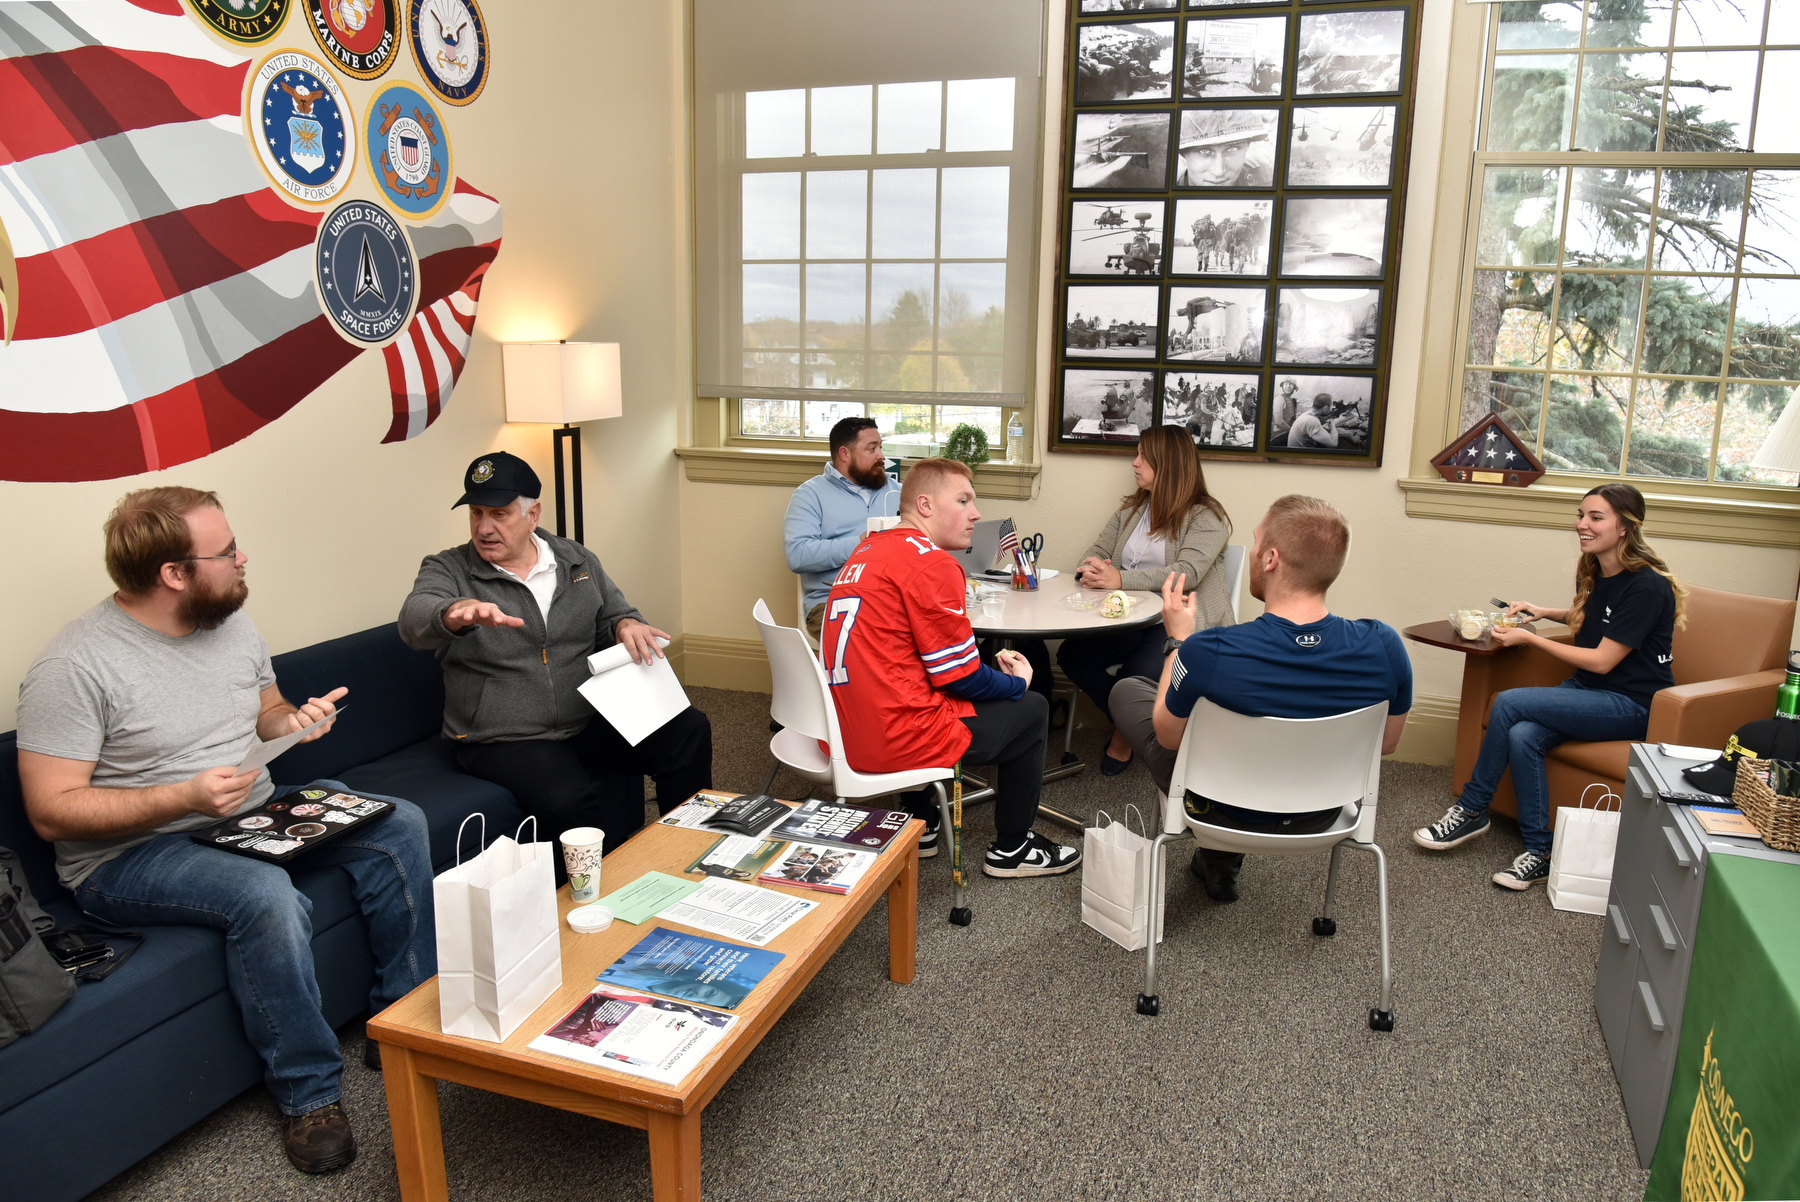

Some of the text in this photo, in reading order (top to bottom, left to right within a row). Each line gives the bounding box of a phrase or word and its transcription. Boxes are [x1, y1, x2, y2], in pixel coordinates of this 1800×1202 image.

[217, 12, 261, 34] ARMY
[313, 9, 393, 68] MARINE CORPS
[261, 55, 338, 95] UNITED STATES
[438, 82, 468, 97] NAVY
[392, 120, 410, 136] STATES
[410, 122, 428, 144] COAST
[390, 137, 402, 172] UNITED
[421, 147, 430, 176] GUARD
[282, 178, 338, 199] AIR FORCE
[405, 173, 419, 181] 1790
[329, 208, 398, 240] UNITED STATES
[340, 308, 402, 336] SPACE FORCE
[360, 309, 382, 317] MMXIX
[819, 596, 862, 686] 17
[800, 806, 842, 832] STATES
[814, 808, 856, 836] FRIENDLY
[830, 810, 870, 838] MILITARY
[712, 949, 733, 965] connect,
[716, 952, 750, 980] Here, veterans
[720, 959, 733, 967] their
[702, 968, 723, 983] families
[662, 1027, 707, 1070] ONONDAGA COUNTY
[1709, 1058, 1754, 1162] OSWEGO
